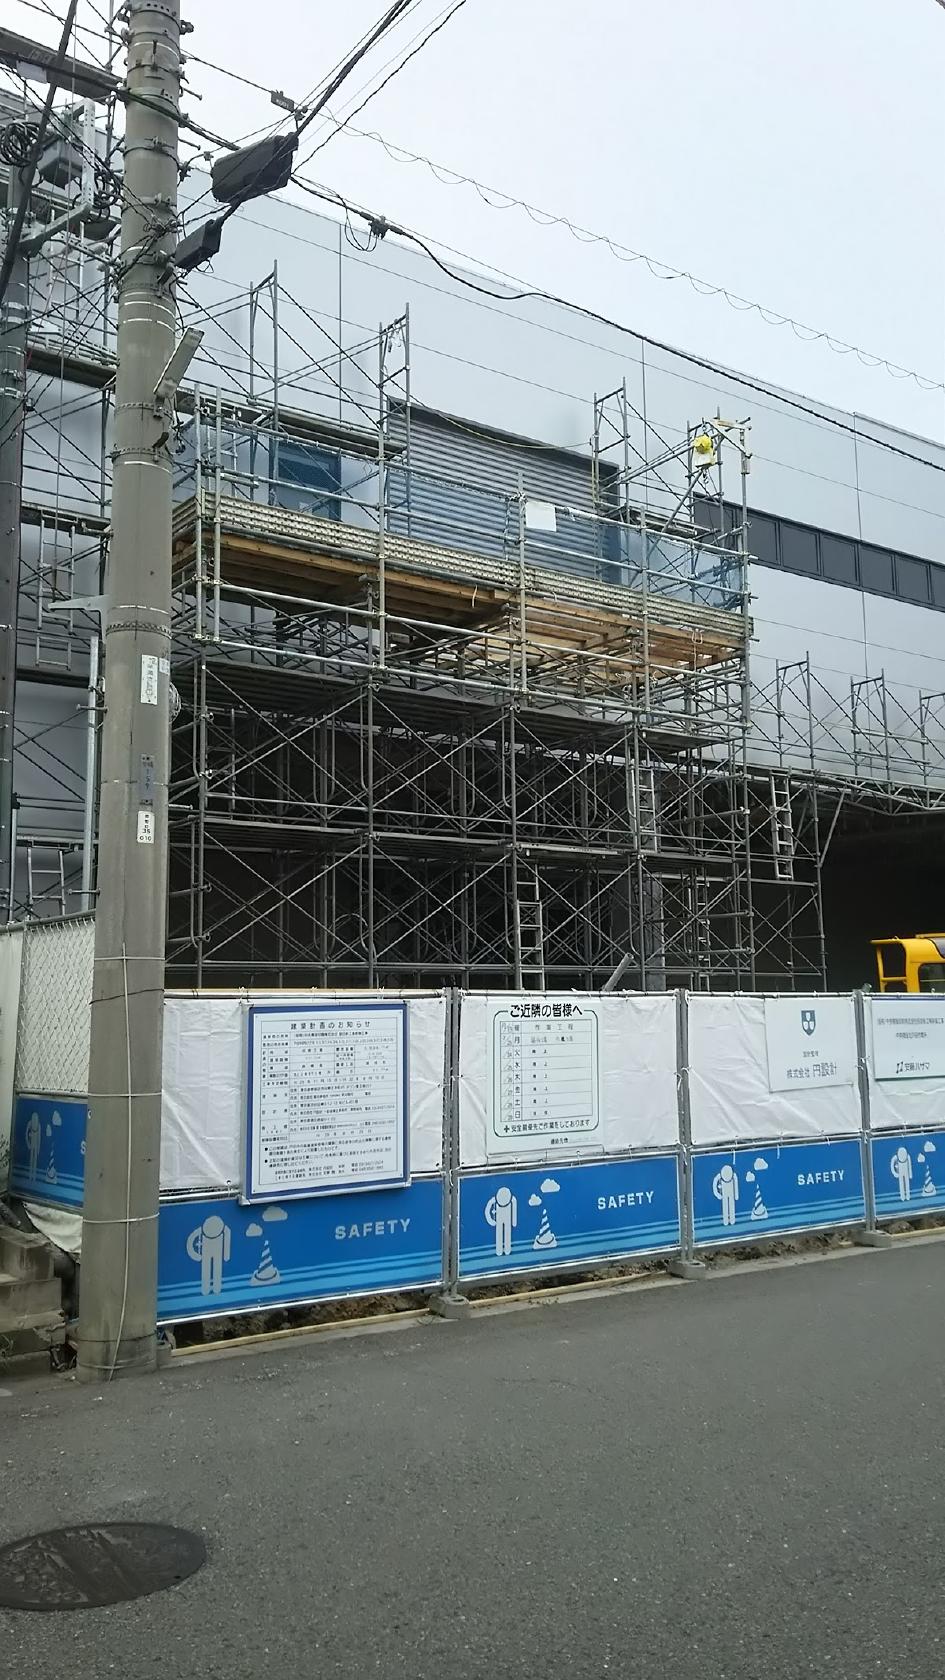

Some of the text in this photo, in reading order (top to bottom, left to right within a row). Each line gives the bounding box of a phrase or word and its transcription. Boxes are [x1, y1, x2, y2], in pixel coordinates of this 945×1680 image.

[510, 1003, 583, 1018] ご近隣の皆様へ
[290, 1020, 371, 1031] 建築計画のお知らせ
[812, 1062, 840, 1078] 円設計
[797, 1169, 845, 1186] SAFETY
[597, 1191, 655, 1211] SAFETY
[334, 1217, 411, 1241] SAFETY
